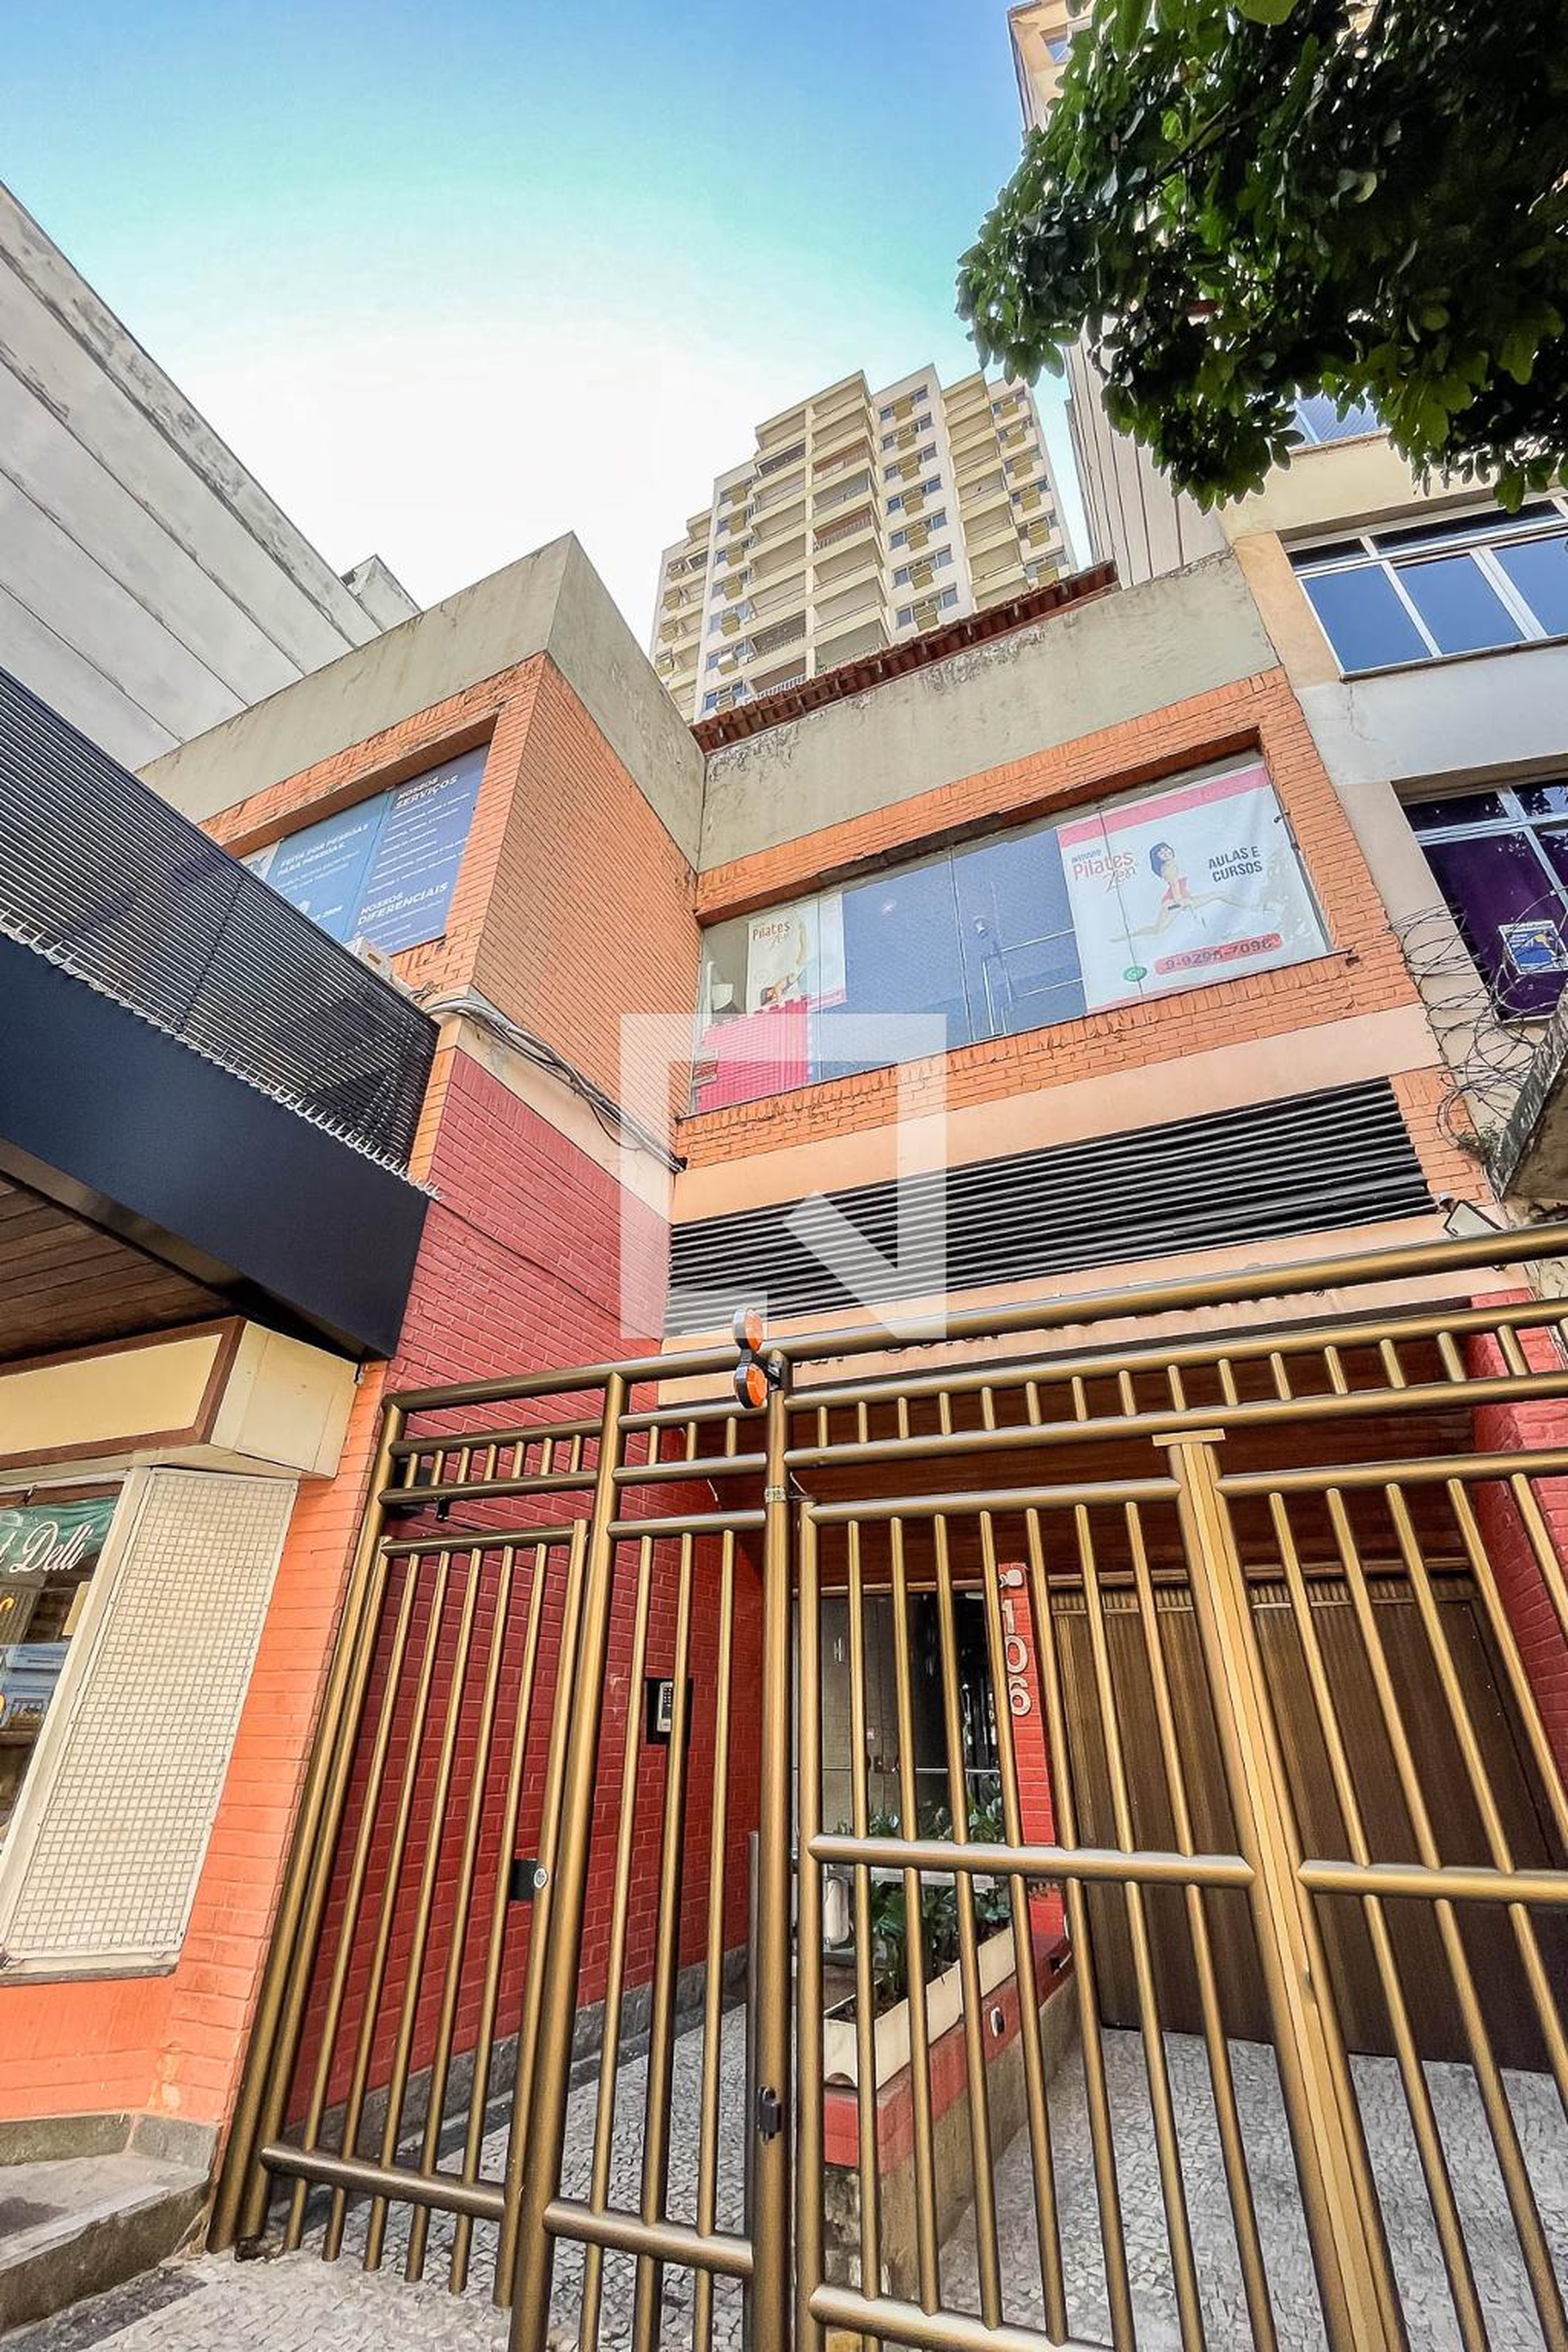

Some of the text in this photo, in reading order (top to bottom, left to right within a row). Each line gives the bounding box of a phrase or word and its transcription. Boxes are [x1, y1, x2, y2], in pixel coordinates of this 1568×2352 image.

[395, 775, 459, 809] SERVIÇOS
[1209, 846, 1261, 869] AULAS E
[1212, 860, 1263, 882] CURSOS
[357, 881, 448, 926] DIFERENCIAIS
[361, 892, 404, 915] NOSSOS
